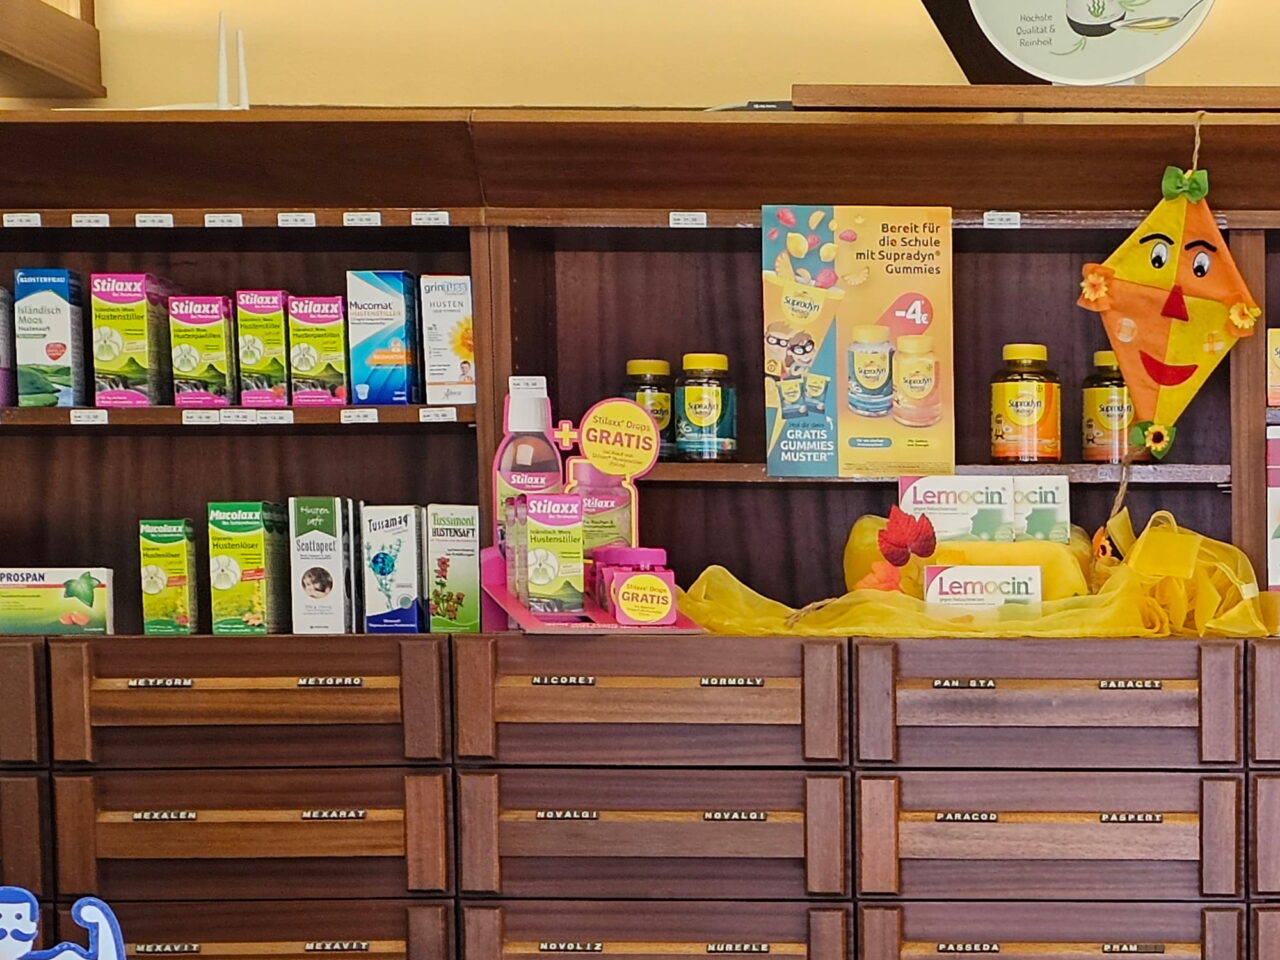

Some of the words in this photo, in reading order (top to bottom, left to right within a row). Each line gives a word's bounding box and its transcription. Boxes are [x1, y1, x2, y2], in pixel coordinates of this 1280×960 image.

[1016, 24, 1048, 35] Qualität
[1020, 38, 1052, 46] Reinheit
[881, 224, 919, 233] Bereit
[923, 224, 940, 233] für
[879, 238, 896, 246] die
[901, 238, 940, 246] Schule
[856, 250, 875, 260] mit
[886, 265, 941, 274] Gummies
[93, 279, 142, 292] Stilaxx
[239, 294, 278, 304] Stilaxx
[17, 306, 61, 315] Isländisch
[171, 302, 219, 314] Stilaxx
[291, 301, 338, 314] Stilaxx
[19, 316, 42, 324] Moos
[787, 430, 827, 439] GRATIS
[586, 428, 653, 451] GRATIS
[780, 441, 834, 450] GUMMIES
[511, 475, 546, 485] Stilaxx
[529, 501, 578, 514] Stilaxx
[210, 510, 260, 520] Mucolaxx
[368, 515, 409, 532] Tussamag
[432, 528, 475, 538] HUSTENSAFT
[530, 535, 581, 544] Hustenstiller
[297, 540, 336, 553] Scottopect
[0, 573, 45, 582] PROSPAN
[622, 591, 669, 605] GRATIS
[128, 678, 192, 687] METFORM
[533, 676, 594, 685] NICORET
[701, 677, 762, 686] NORMOLY
[933, 679, 960, 689] PAN
[969, 679, 996, 689] STA
[133, 811, 196, 820] MEXALEN
[302, 810, 365, 819] MEXARAT
[537, 810, 597, 819] NOVALGI
[704, 811, 764, 821] NOVALGI
[935, 813, 998, 822] PARACOD
[136, 943, 199, 953] MEXAVIT
[305, 942, 368, 951] MEXAVIT
[540, 942, 602, 952] NOVOLIZ
[938, 943, 999, 952] PASSEDA
